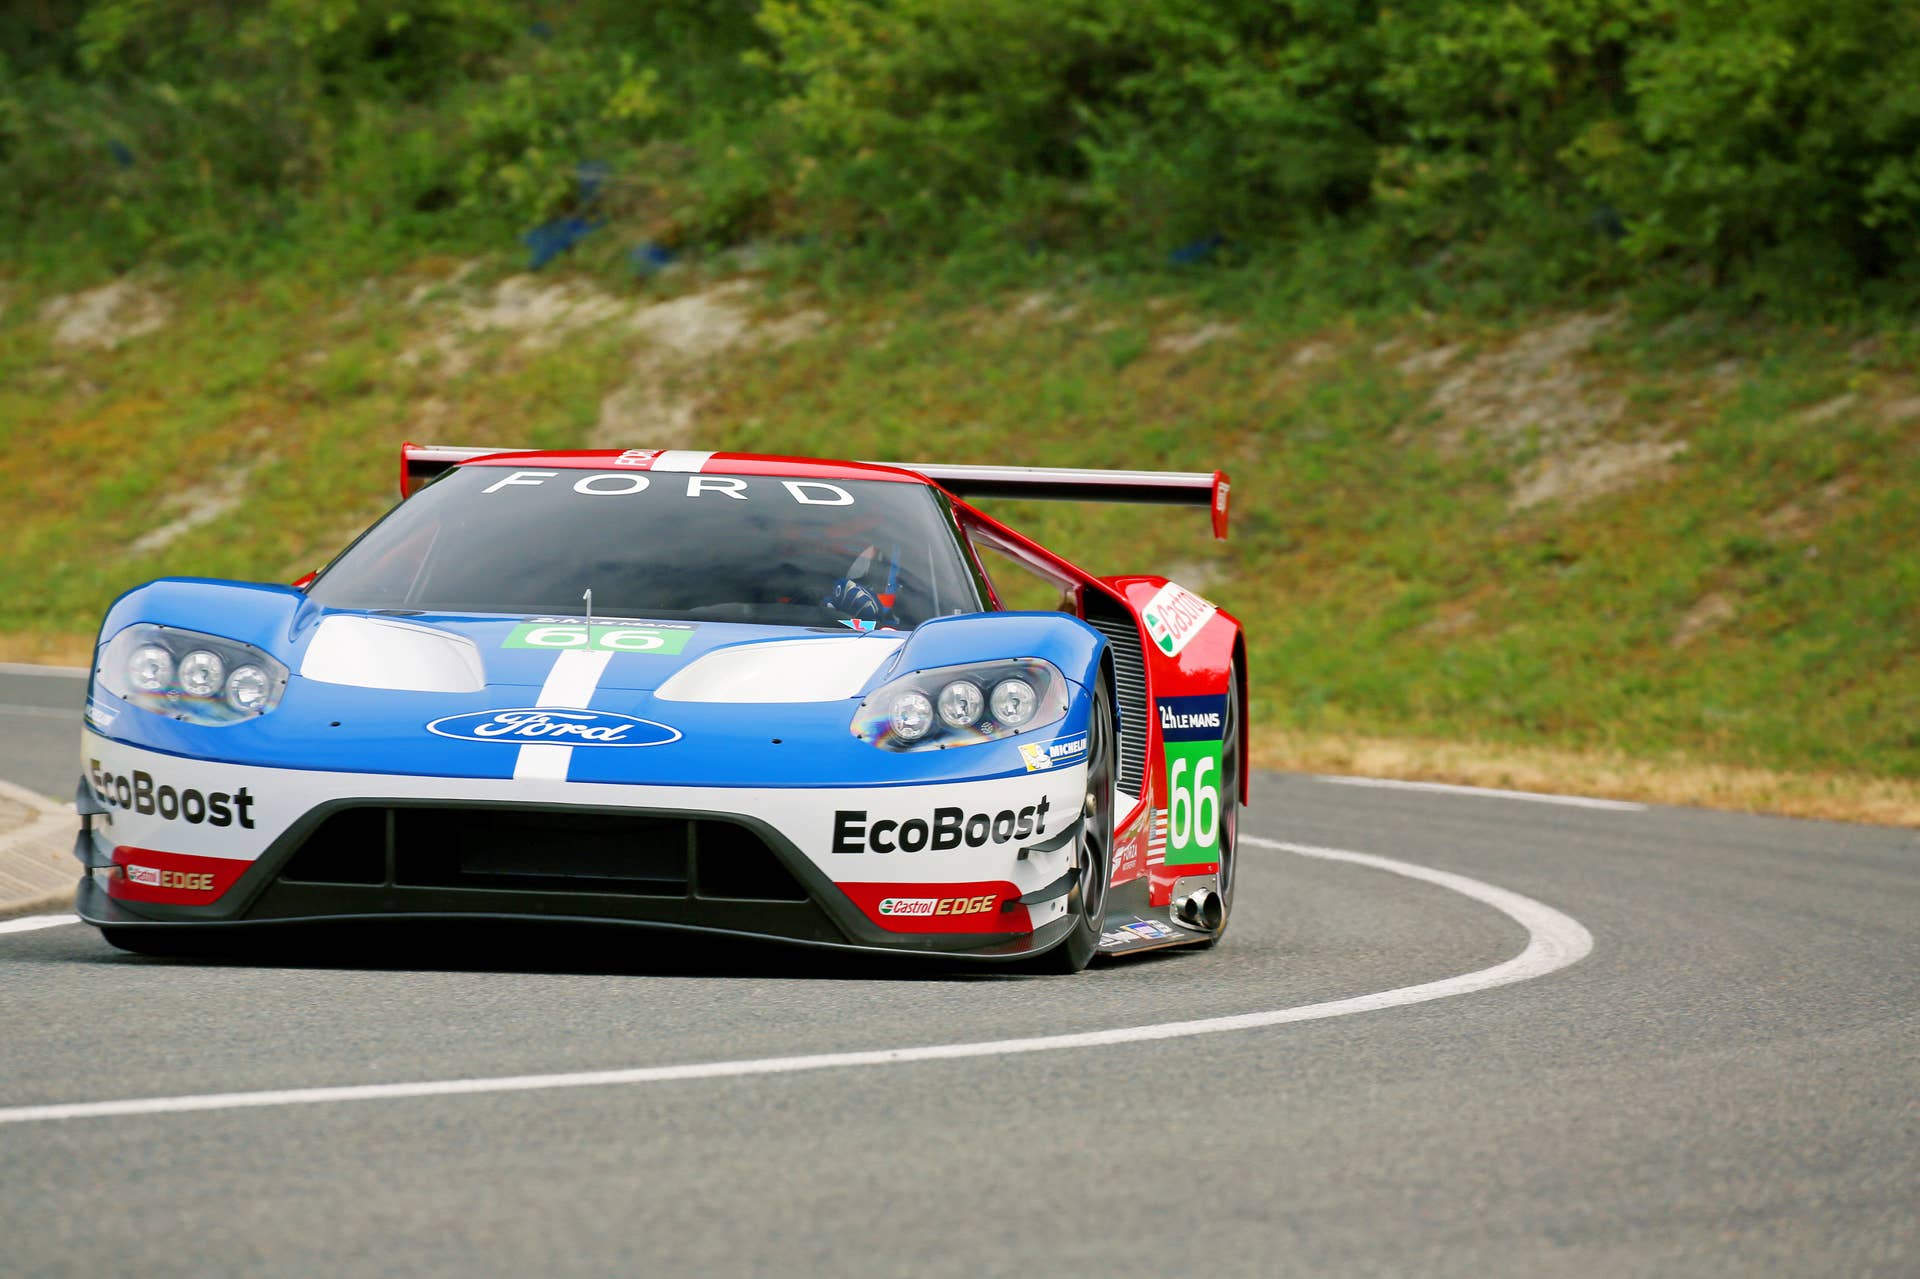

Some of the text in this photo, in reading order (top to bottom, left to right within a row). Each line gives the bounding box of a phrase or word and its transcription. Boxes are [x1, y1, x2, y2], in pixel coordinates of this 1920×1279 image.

[481, 471, 854, 506] FORD
[525, 626, 665, 650] 66
[473, 711, 635, 741] Ford
[1189, 713, 1221, 728] MANS
[90, 758, 255, 830] EcoBoost
[1170, 756, 1219, 850] 66
[832, 795, 1050, 854] EcoBoost
[161, 870, 216, 891] EDGE
[893, 894, 998, 916] Castrol EDGE
